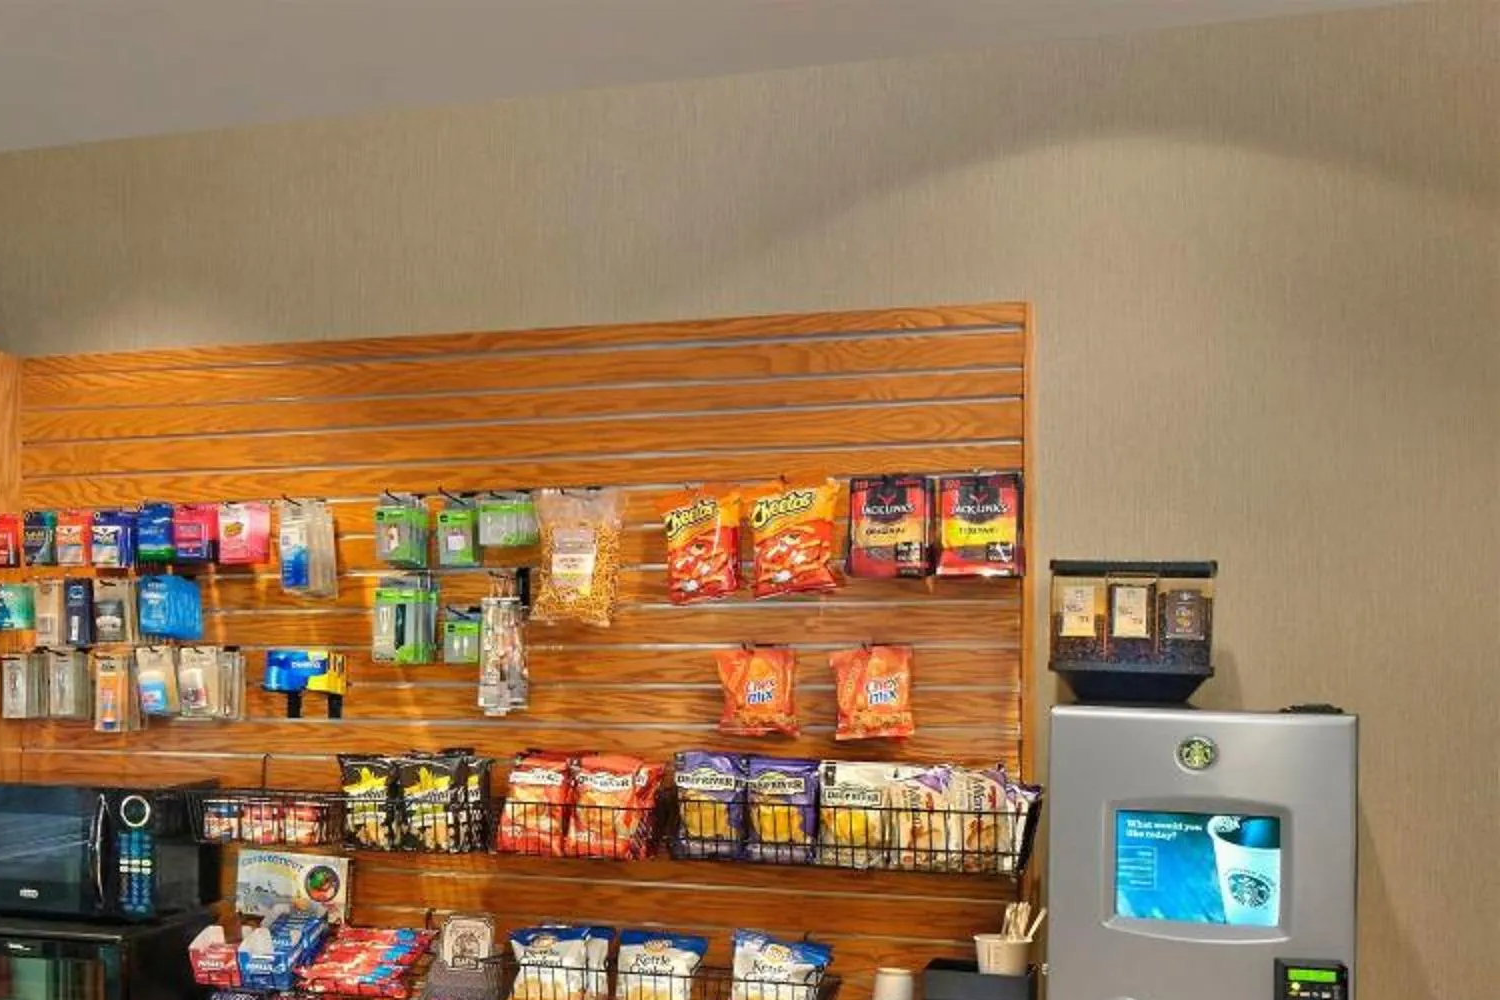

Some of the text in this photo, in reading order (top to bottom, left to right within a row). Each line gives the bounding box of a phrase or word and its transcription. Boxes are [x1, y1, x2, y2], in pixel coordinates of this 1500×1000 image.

[665, 500, 719, 538] Cheetos
[752, 489, 816, 528] Cheetos
[1125, 819, 1152, 830] What
[1146, 830, 1178, 842] today?
